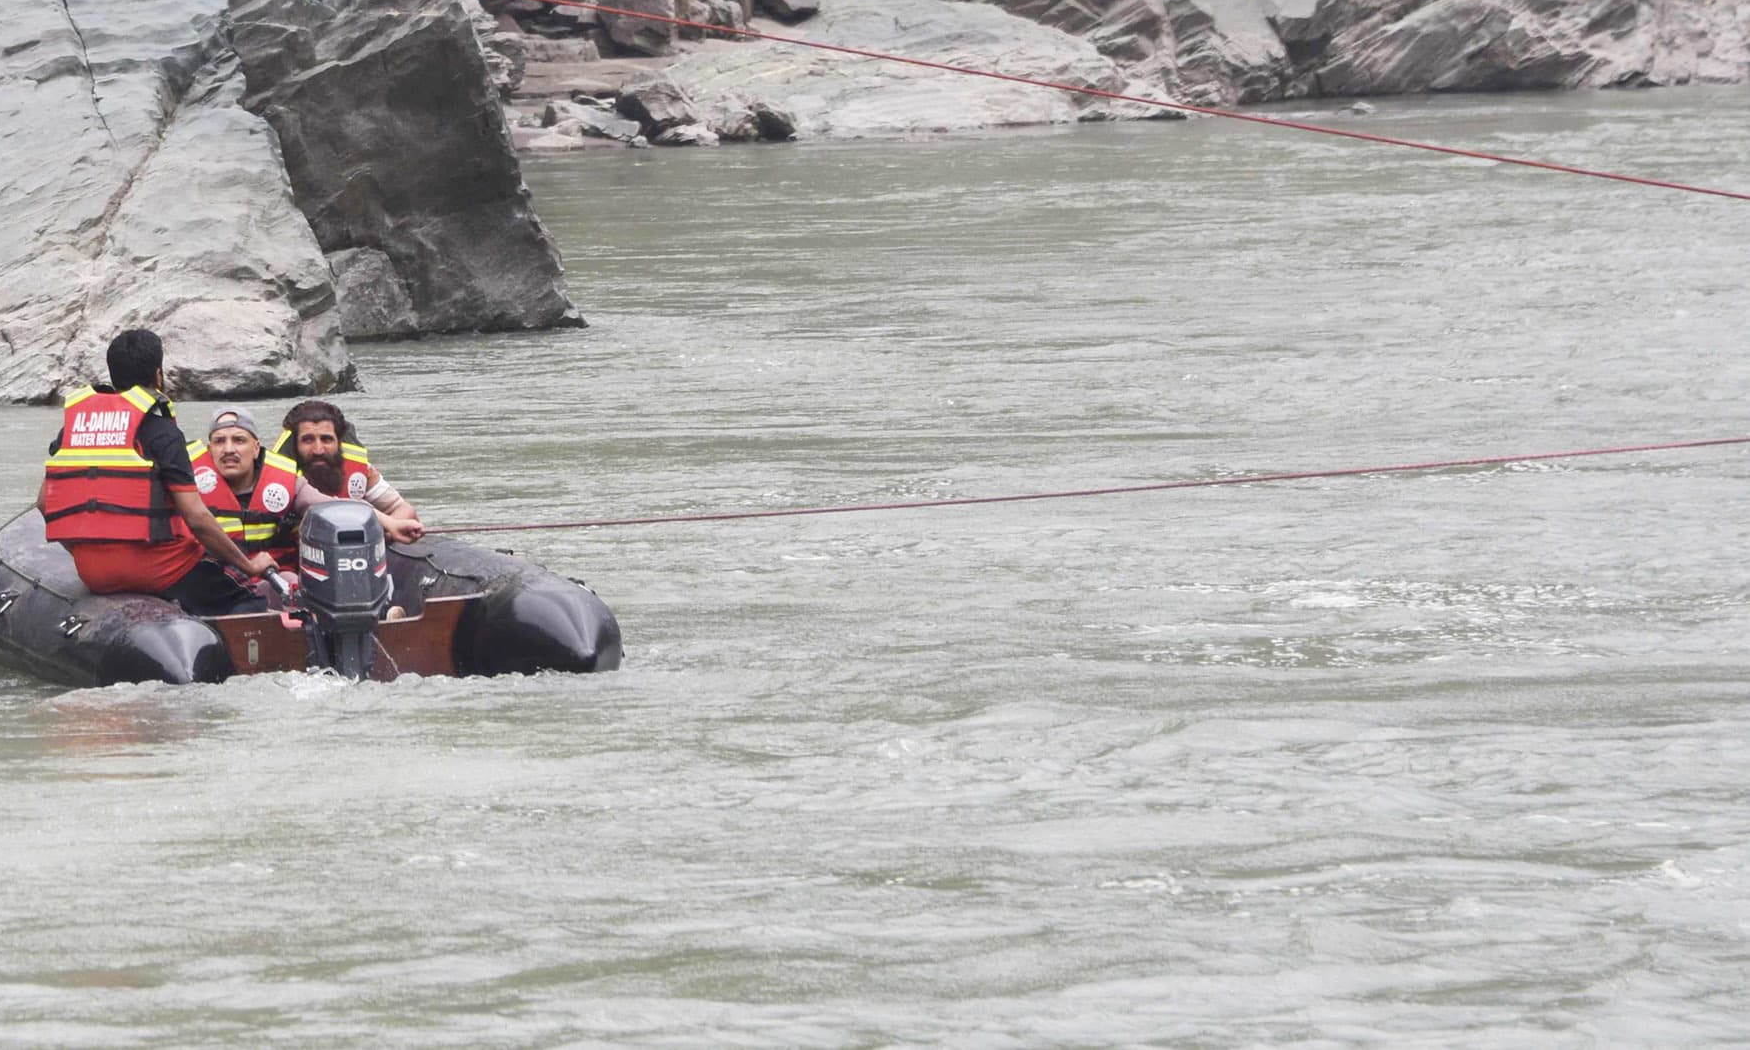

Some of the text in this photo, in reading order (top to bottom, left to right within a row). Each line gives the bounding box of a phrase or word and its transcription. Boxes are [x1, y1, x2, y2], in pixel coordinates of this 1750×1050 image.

[72, 411, 130, 432] AL-DAWAH
[70, 432, 127, 447] WATER RESCUE
[337, 558, 368, 571] 30
